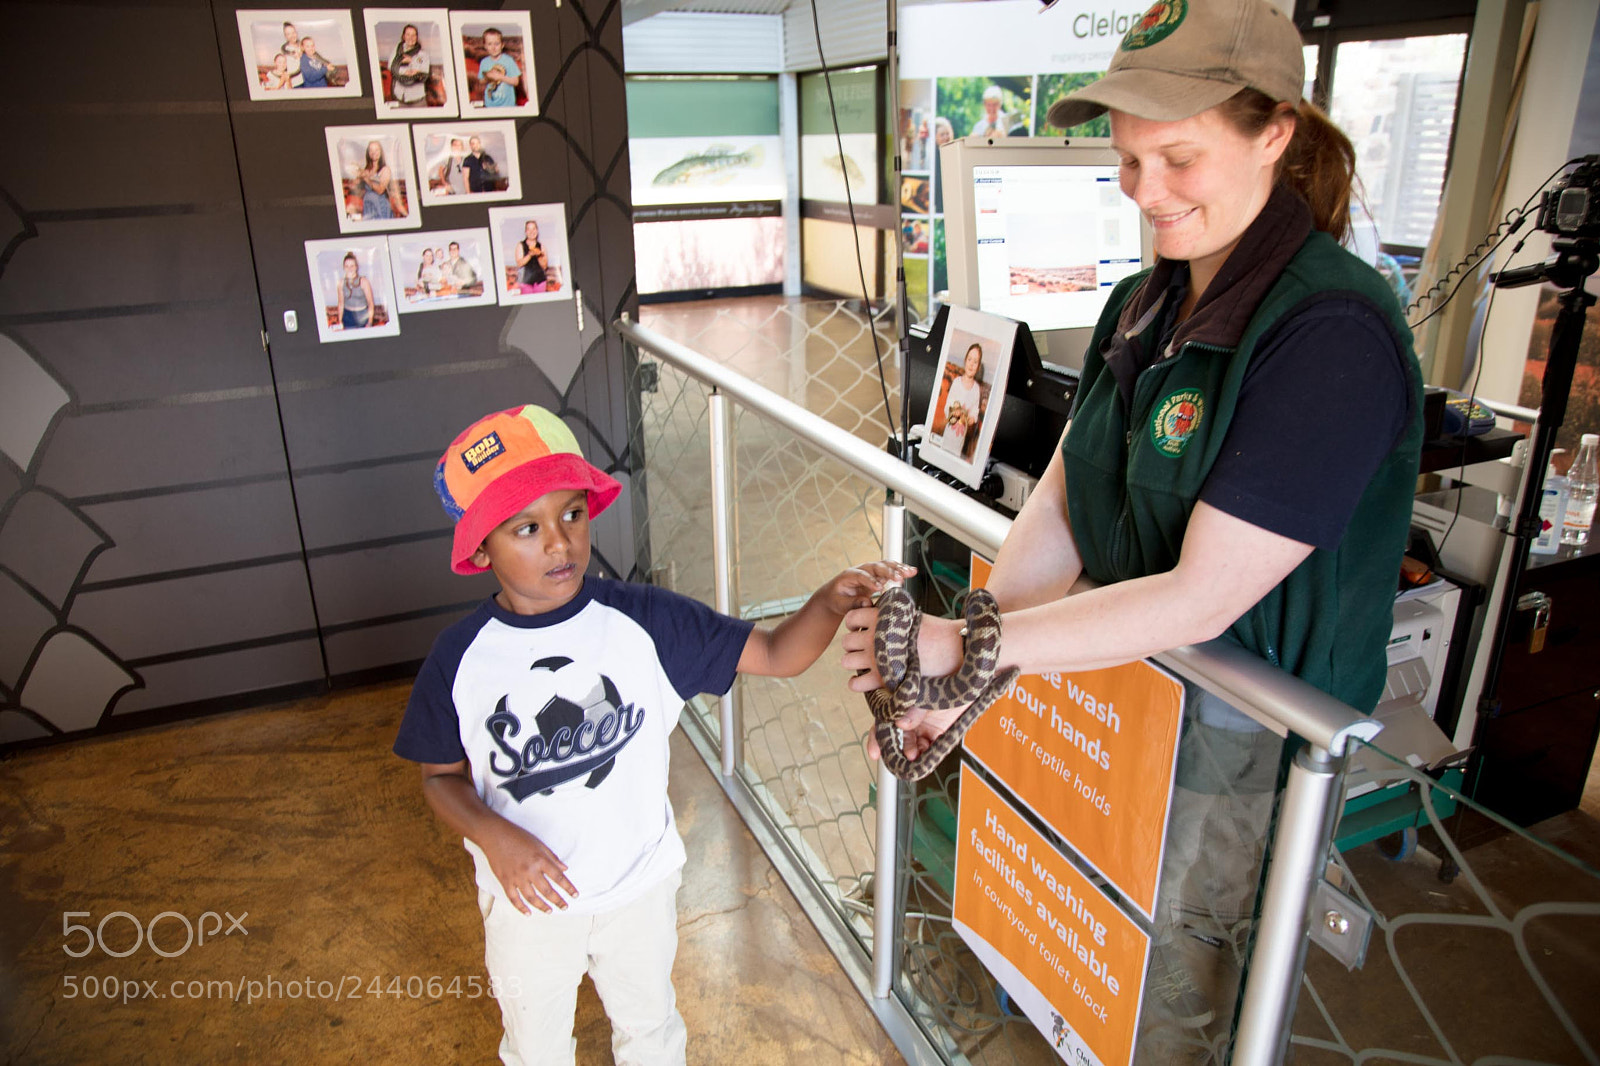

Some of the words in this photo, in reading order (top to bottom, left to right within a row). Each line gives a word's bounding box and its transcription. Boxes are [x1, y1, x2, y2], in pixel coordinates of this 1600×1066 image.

[464, 436, 496, 463] Bob
[485, 702, 646, 777] Soccer
[1007, 681, 1047, 719] your
[1050, 705, 1110, 771] hands
[1067, 679, 1120, 734] wash
[999, 715, 1029, 746] after
[1030, 741, 1071, 782] reptile
[1073, 773, 1111, 817] holds
[970, 828, 1033, 907] facilities
[1036, 901, 1120, 997] available
[985, 808, 1028, 864] Hand
[1031, 856, 1108, 947] washing
[973, 869, 983, 889] in
[984, 885, 1037, 947] courtyard
[1039, 942, 1070, 984] toilet
[1072, 977, 1108, 1025] block
